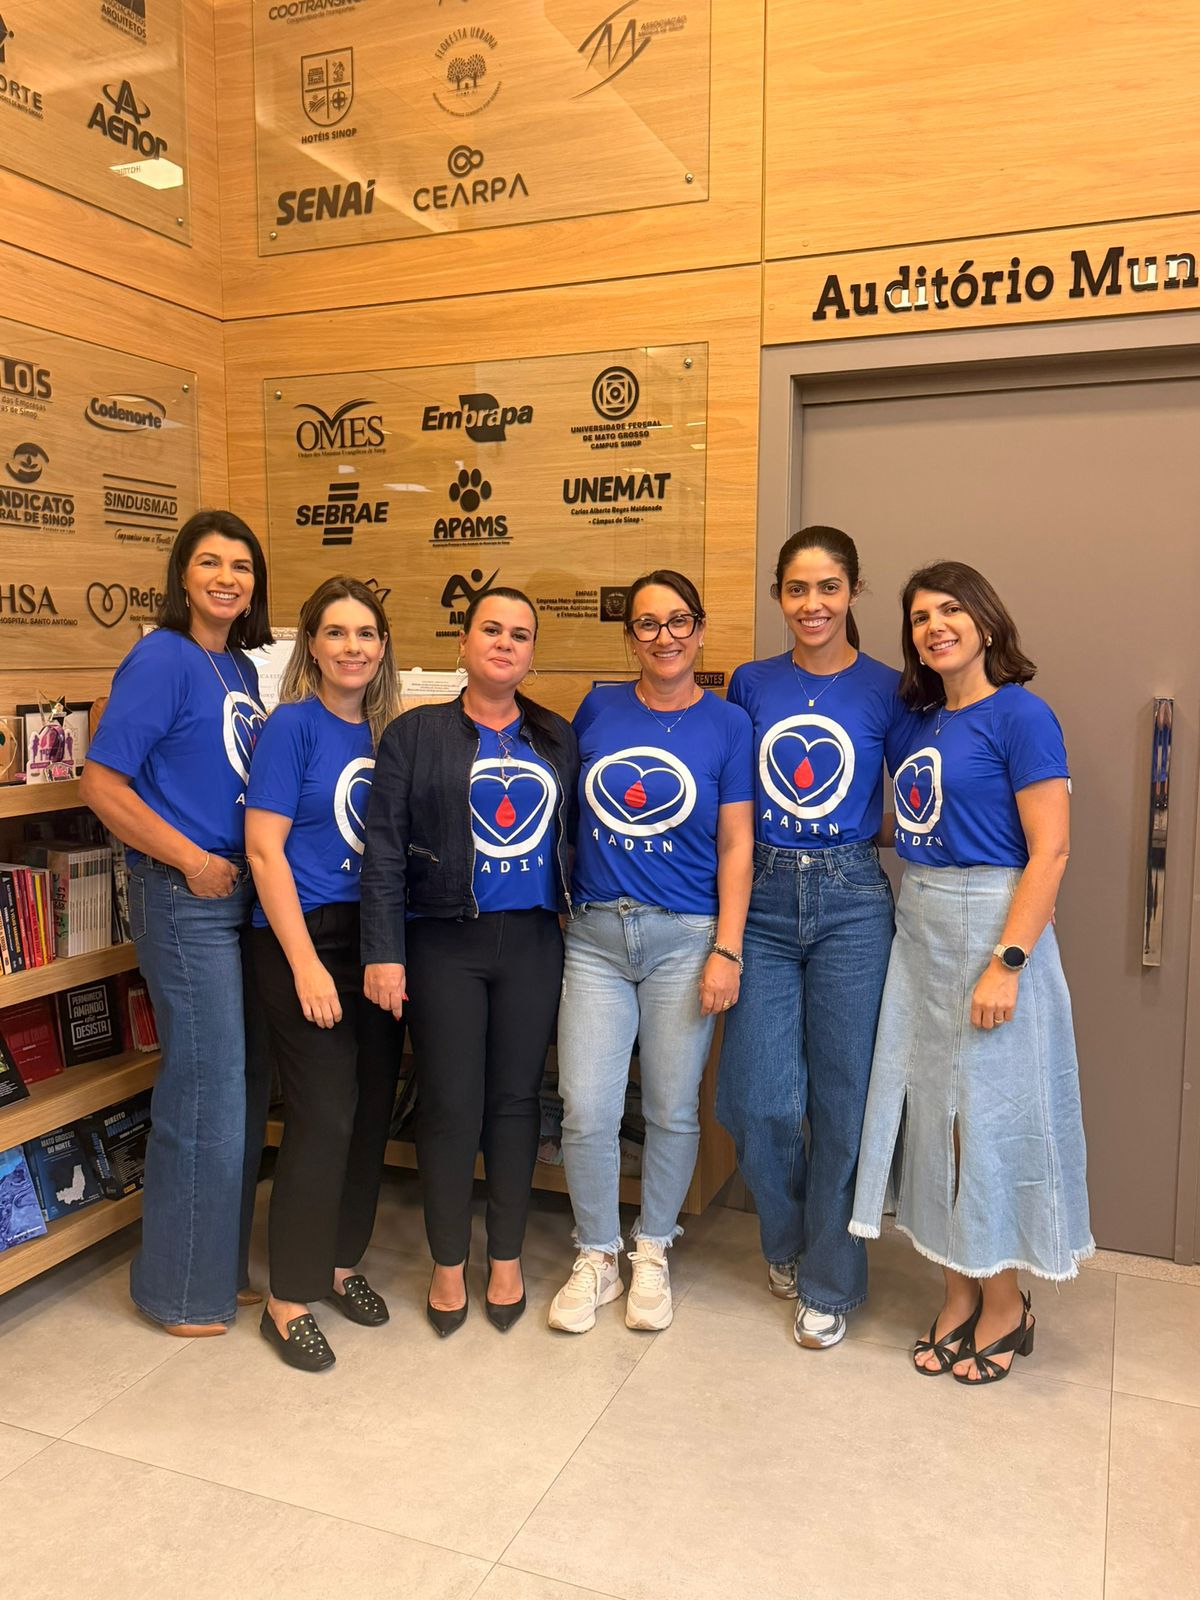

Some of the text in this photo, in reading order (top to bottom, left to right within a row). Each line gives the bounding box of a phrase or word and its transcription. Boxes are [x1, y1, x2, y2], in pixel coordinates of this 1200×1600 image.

[101, 4, 147, 38] ARQUITETOS
[434, 26, 498, 59] FLORESTA URBANA
[301, 128, 357, 144] HOTÉIS SINOP
[413, 173, 529, 212] CEARPA
[812, 246, 1199, 321] Auditório Mun
[91, 397, 162, 428] Codenorte
[421, 404, 533, 431] Embrapa
[296, 415, 385, 451] OMES
[571, 420, 662, 434] UNIVERSIDADE FEDERAL
[595, 433, 616, 441] MATO
[617, 431, 650, 439] GROSSO
[591, 442, 619, 450] CAMPUS
[563, 472, 671, 504] UNEMAT
[0, 489, 75, 515] NDICATO
[104, 491, 178, 516] SINDUSMAD
[296, 501, 389, 526] SEBRAE
[24, 511, 40, 523] DE
[42, 513, 75, 527] SINOP
[434, 515, 508, 539] APAMS
[623, 516, 640, 524] Sinop
[0, 584, 59, 614] HSA
[130, 587, 166, 613] Refe
[30, 618, 51, 626] SANTO
[762, 809, 839, 836] AADIN
[592, 828, 673, 853] AADIN
[480, 854, 544, 874] ADIN
[73, 1000, 105, 1018] AMANDO
[75, 1020, 107, 1039] DESISTA
[104, 1111, 126, 1127] DIREITO
